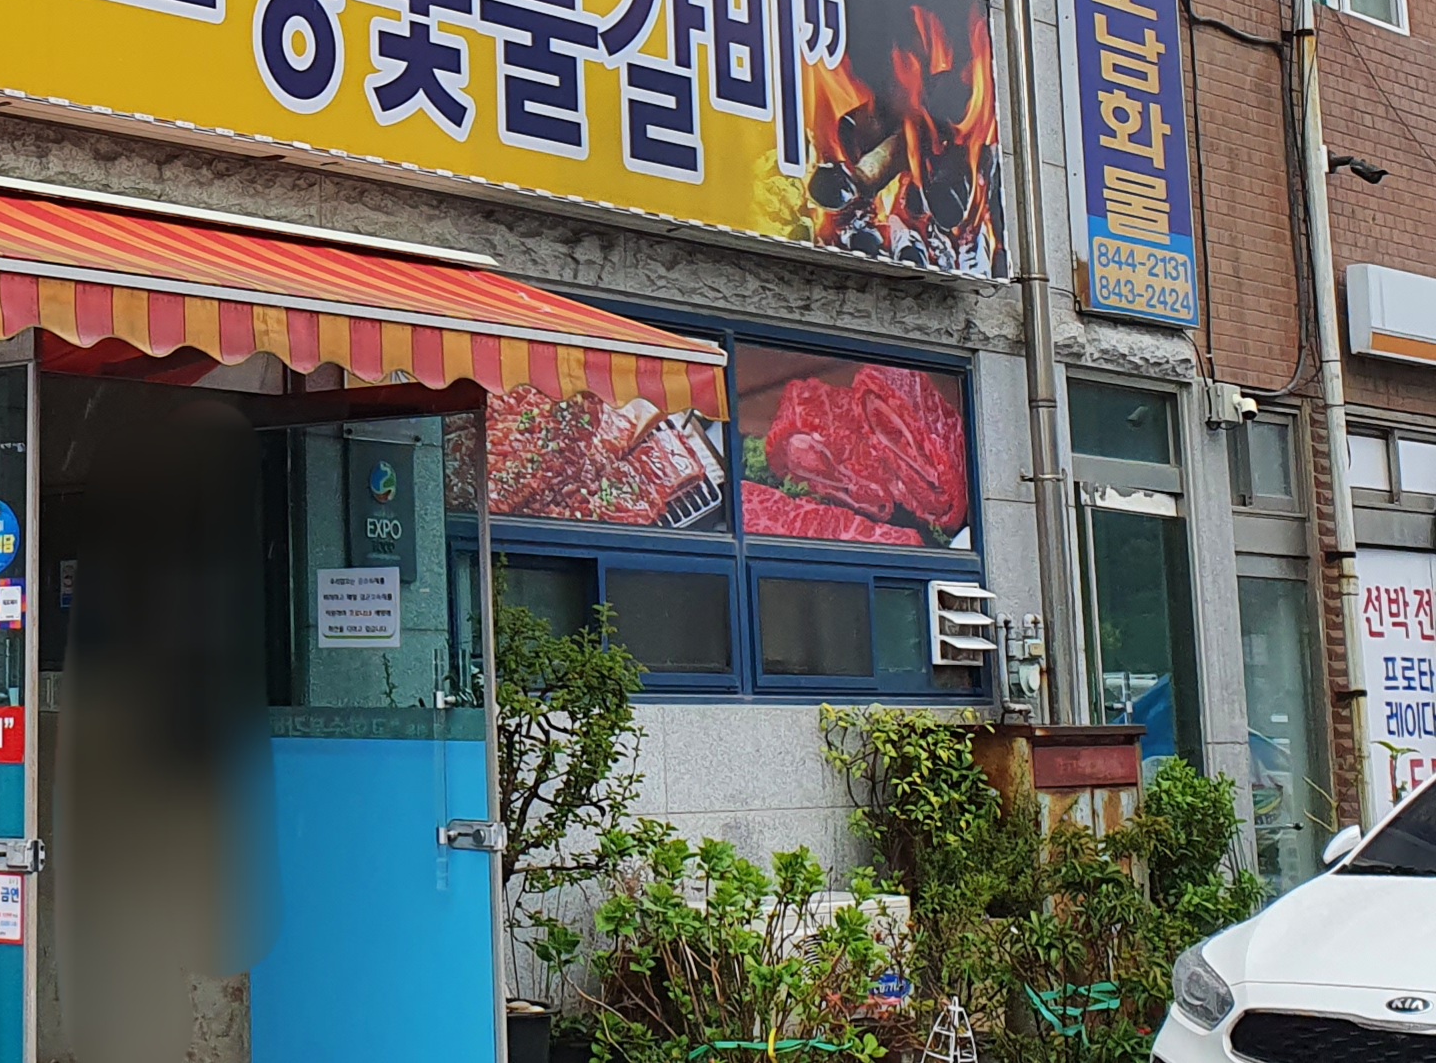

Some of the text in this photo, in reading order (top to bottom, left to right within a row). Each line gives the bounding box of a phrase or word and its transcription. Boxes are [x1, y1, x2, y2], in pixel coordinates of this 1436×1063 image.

[1097, 242, 1189, 284] 844-2131
[1099, 275, 1192, 315] 843-2424
[367, 518, 402, 539] EXPO
[1392, 998, 1424, 1010] KIA
